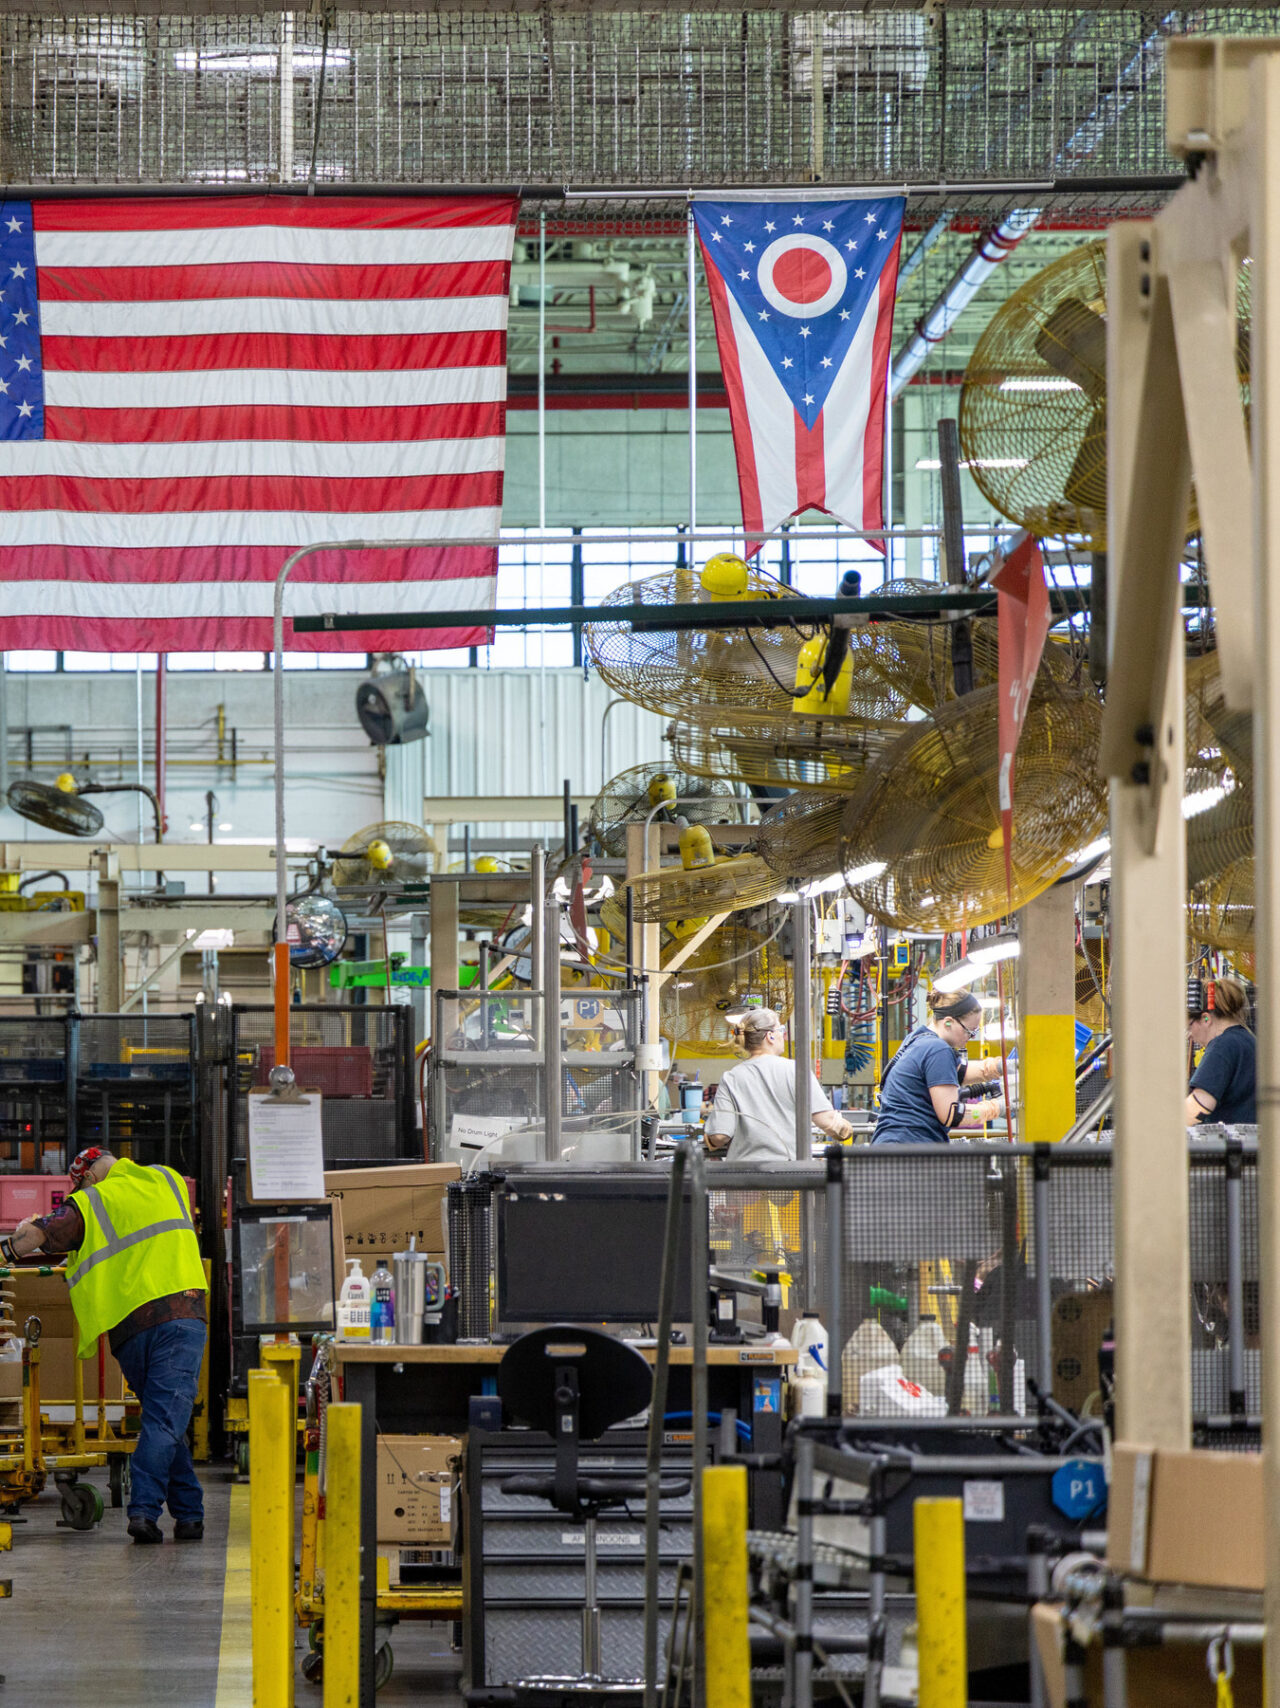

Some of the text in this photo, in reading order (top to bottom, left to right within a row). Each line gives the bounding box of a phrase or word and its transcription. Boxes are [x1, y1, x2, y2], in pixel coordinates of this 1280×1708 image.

[580, 1001, 597, 1015] P1
[467, 1128, 483, 1136] Drum
[1070, 1479, 1095, 1499] P1
